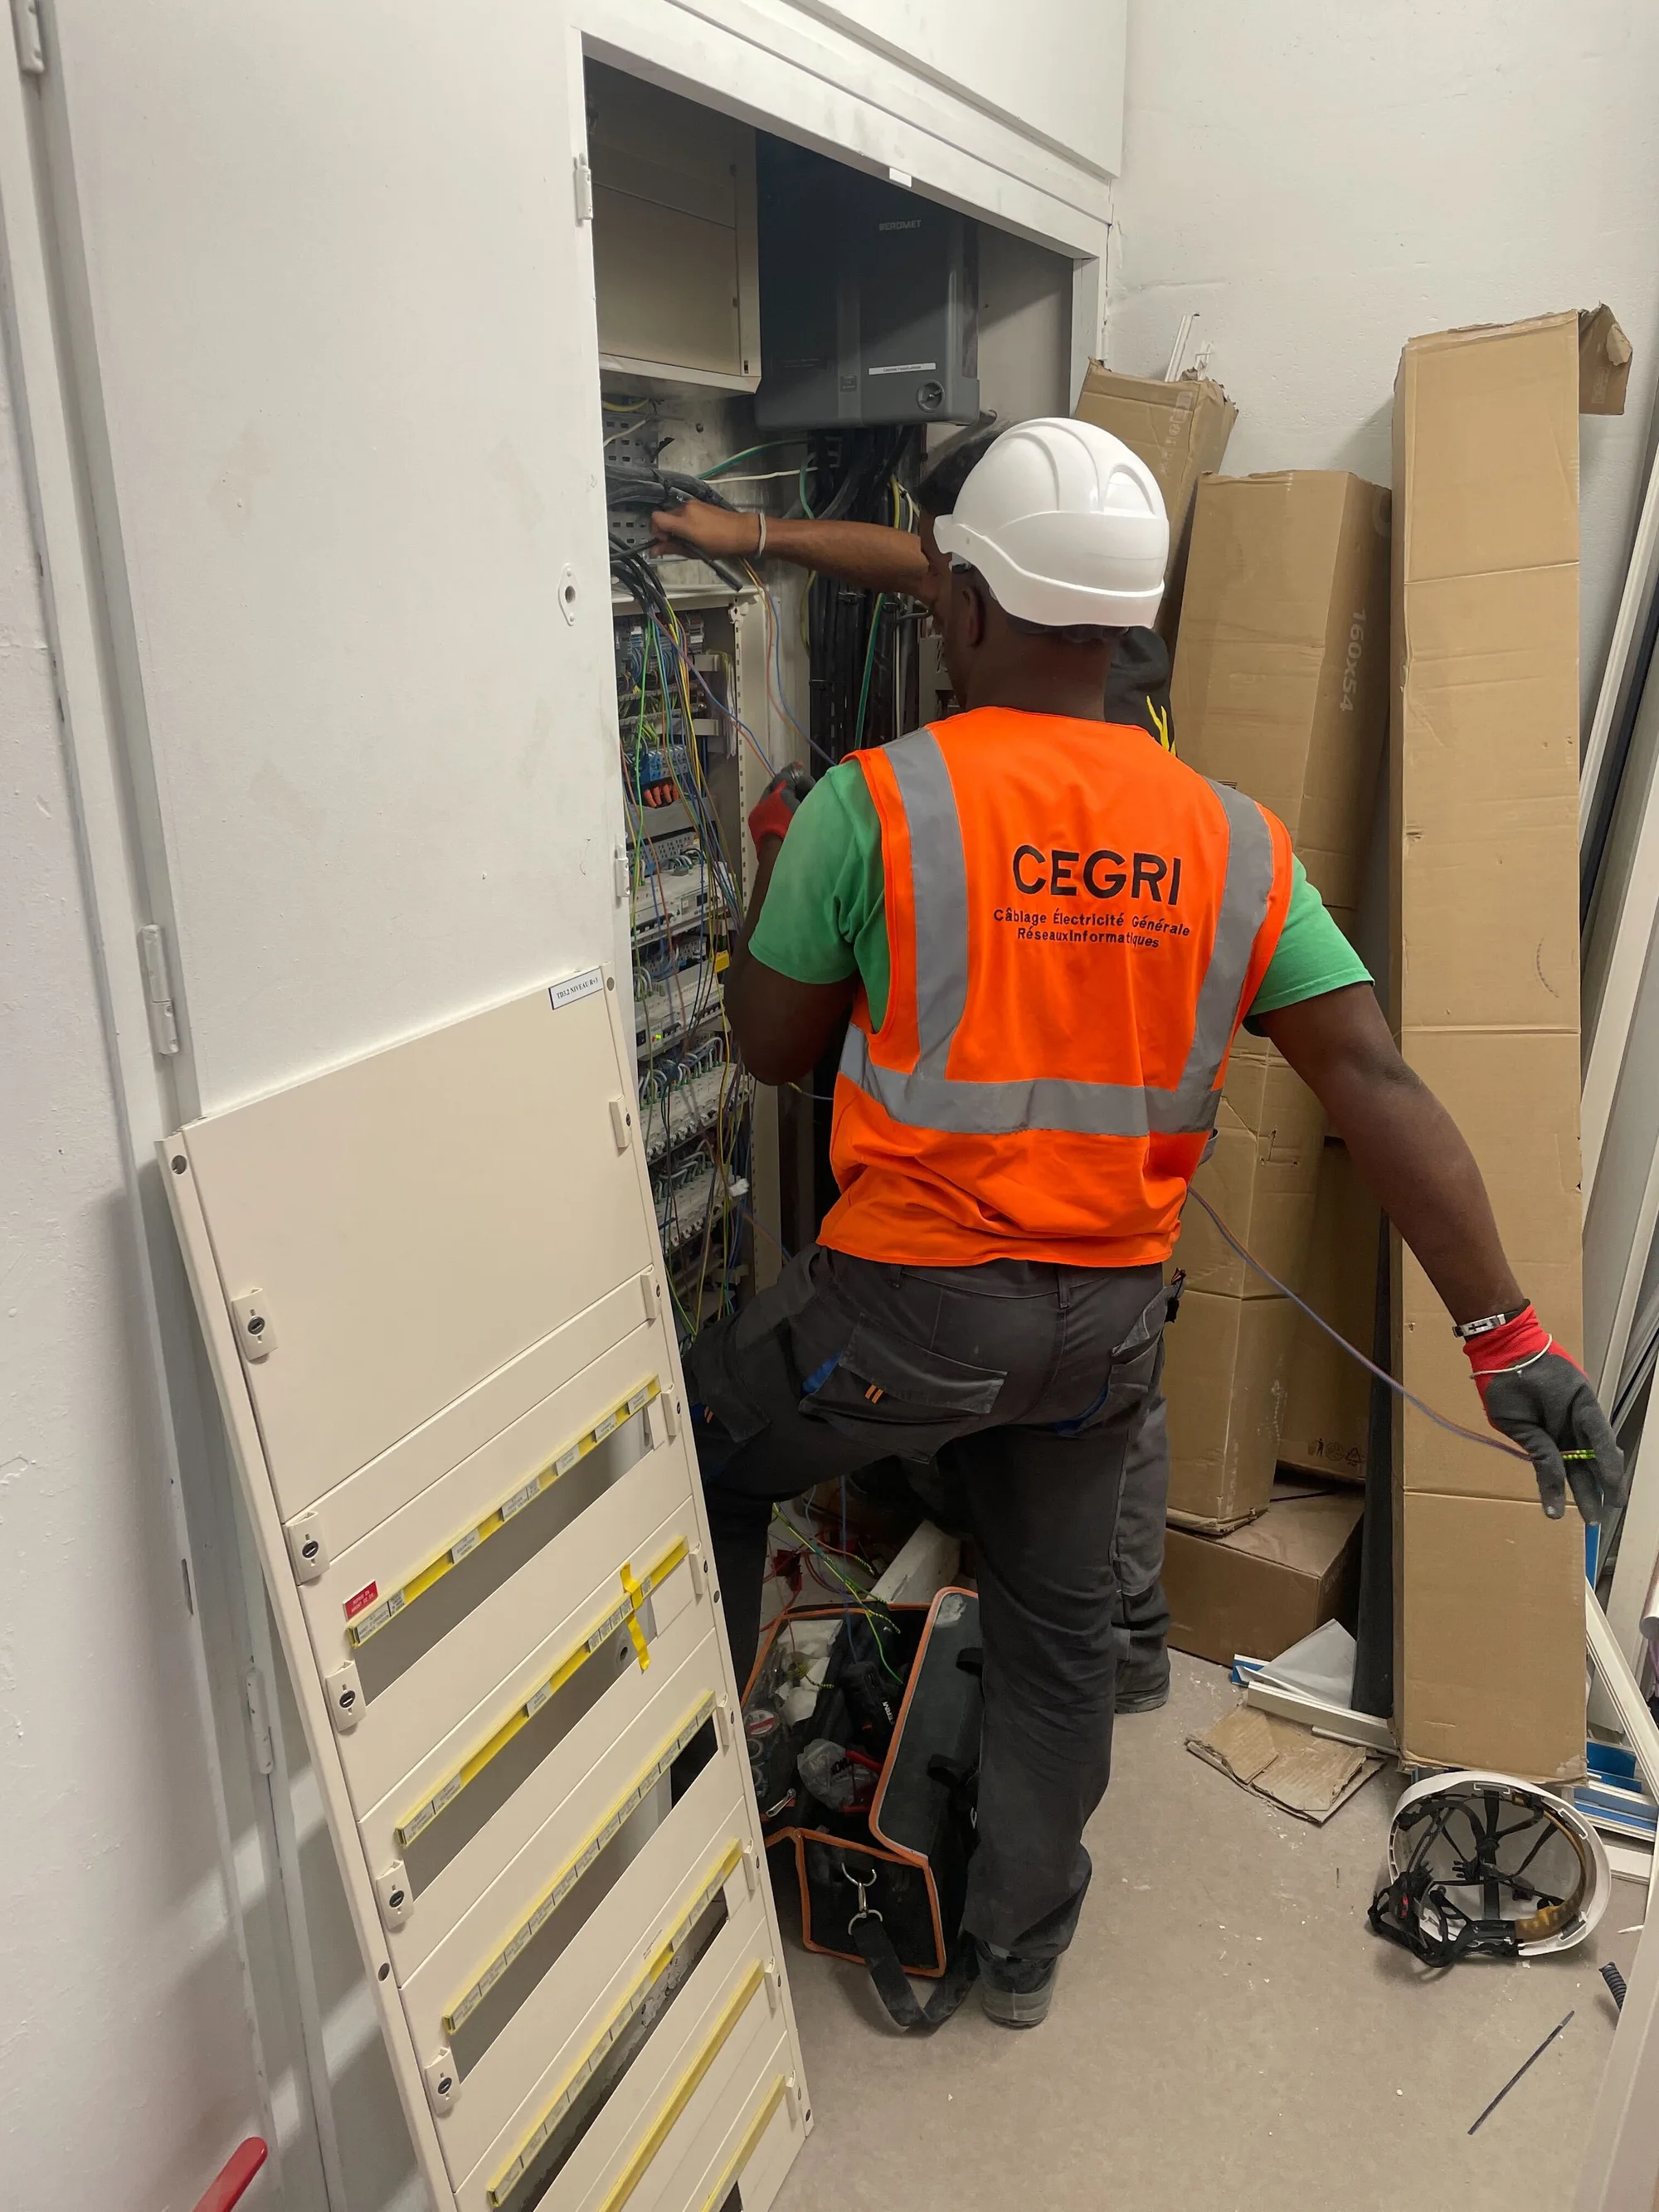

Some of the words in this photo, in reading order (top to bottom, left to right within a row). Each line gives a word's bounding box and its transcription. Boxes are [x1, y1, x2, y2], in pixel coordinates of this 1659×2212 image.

[1339, 607, 1367, 712] 160x54
[1012, 843, 1181, 906] CEGRI
[993, 907, 1047, 926] Câblage
[1053, 907, 1125, 927] Électricité
[1131, 912, 1191, 937] Générale
[570, 981, 589, 994] NIVEAU
